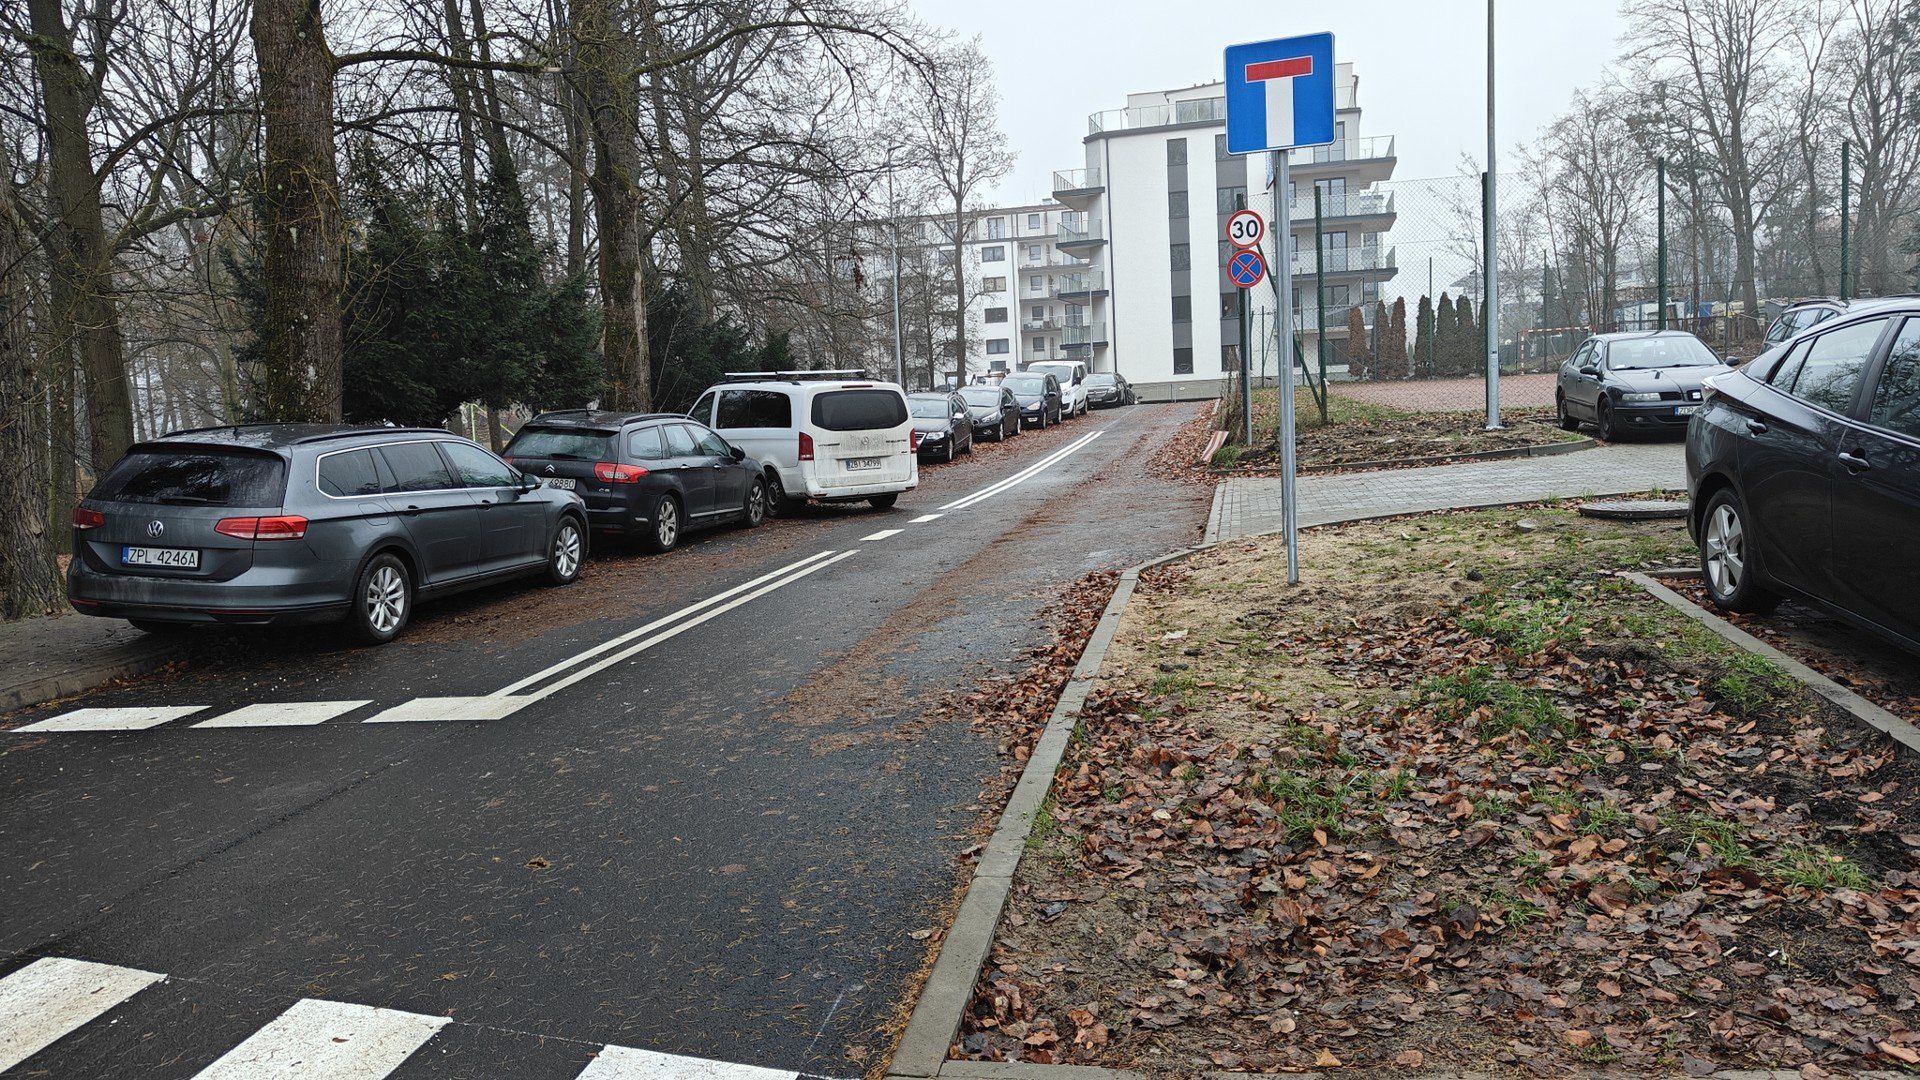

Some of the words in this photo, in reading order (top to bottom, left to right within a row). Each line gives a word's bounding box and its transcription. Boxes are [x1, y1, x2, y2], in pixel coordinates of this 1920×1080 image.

[1232, 219, 1258, 239] 30
[128, 548, 152, 564] ZPL
[157, 550, 196, 567] 4246A
